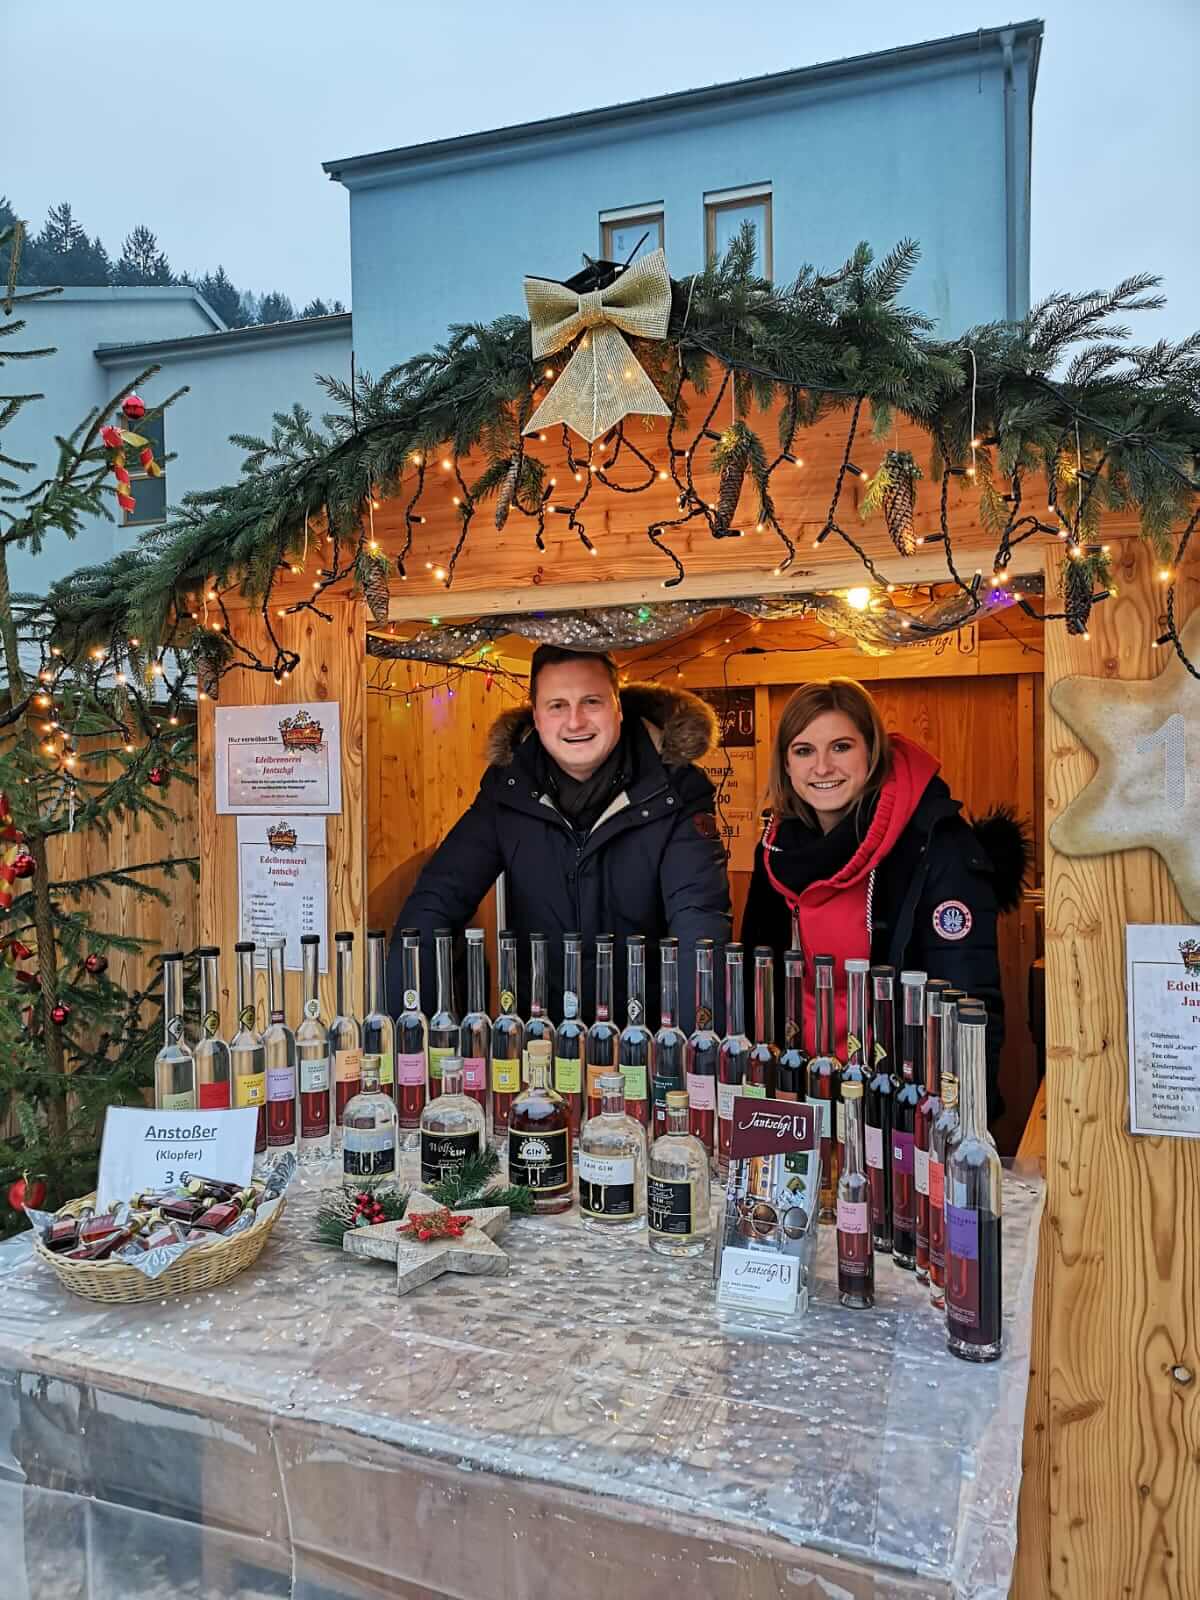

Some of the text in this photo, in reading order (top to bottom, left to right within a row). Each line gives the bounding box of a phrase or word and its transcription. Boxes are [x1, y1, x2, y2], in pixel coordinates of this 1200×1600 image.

[1136, 713, 1185, 809] 1
[145, 1124, 218, 1140] Anstoßer
[738, 1111, 792, 1138] Jantschgi
[156, 1148, 202, 1162] (Klopfer)
[526, 1148, 542, 1156] GIN
[164, 1170, 174, 1184] 3
